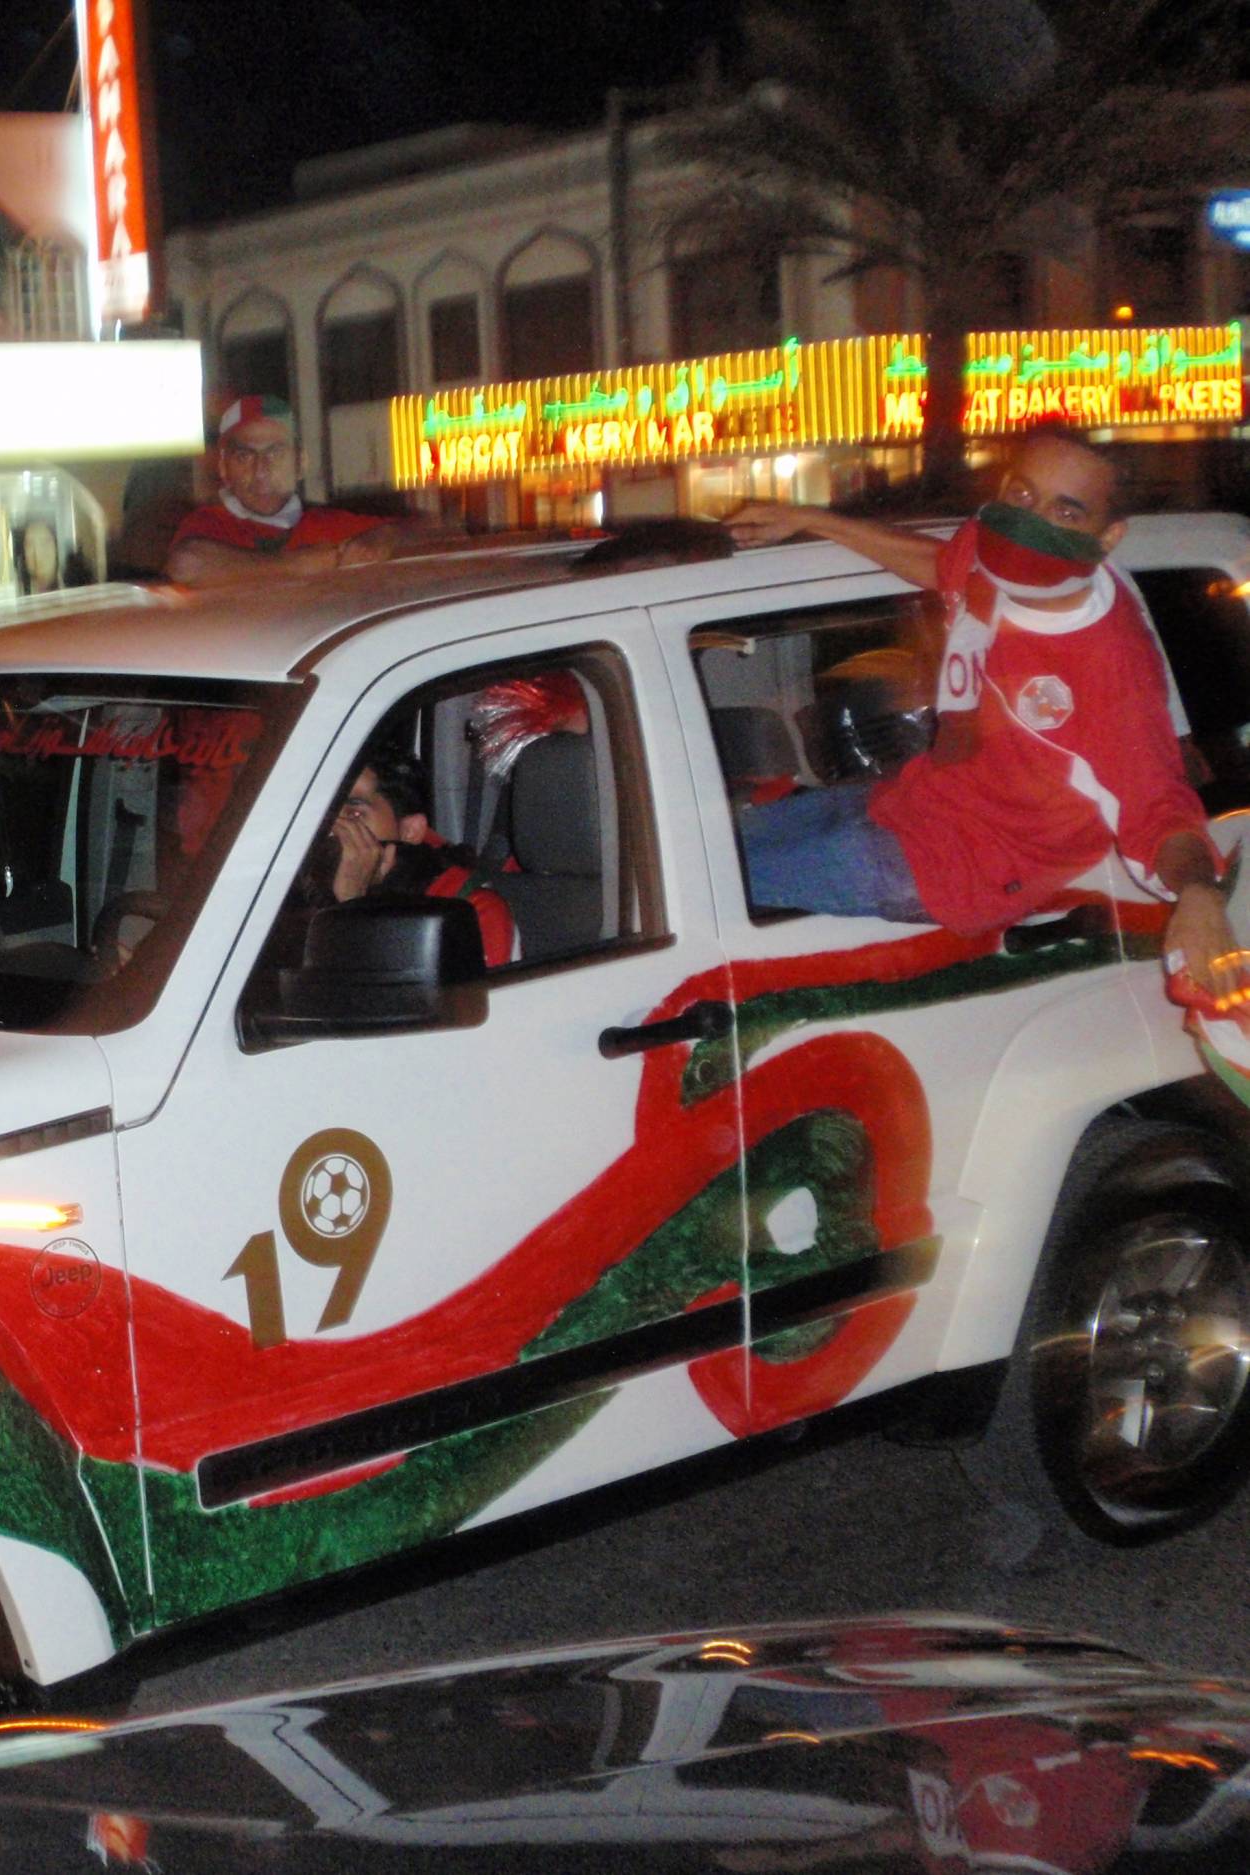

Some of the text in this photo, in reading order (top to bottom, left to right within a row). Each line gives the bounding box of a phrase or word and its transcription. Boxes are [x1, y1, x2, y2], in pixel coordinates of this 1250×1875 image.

[1008, 383, 1115, 420] BAKERY
[221, 1127, 393, 1349] 19
[40, 1263, 93, 1289] Jeep
